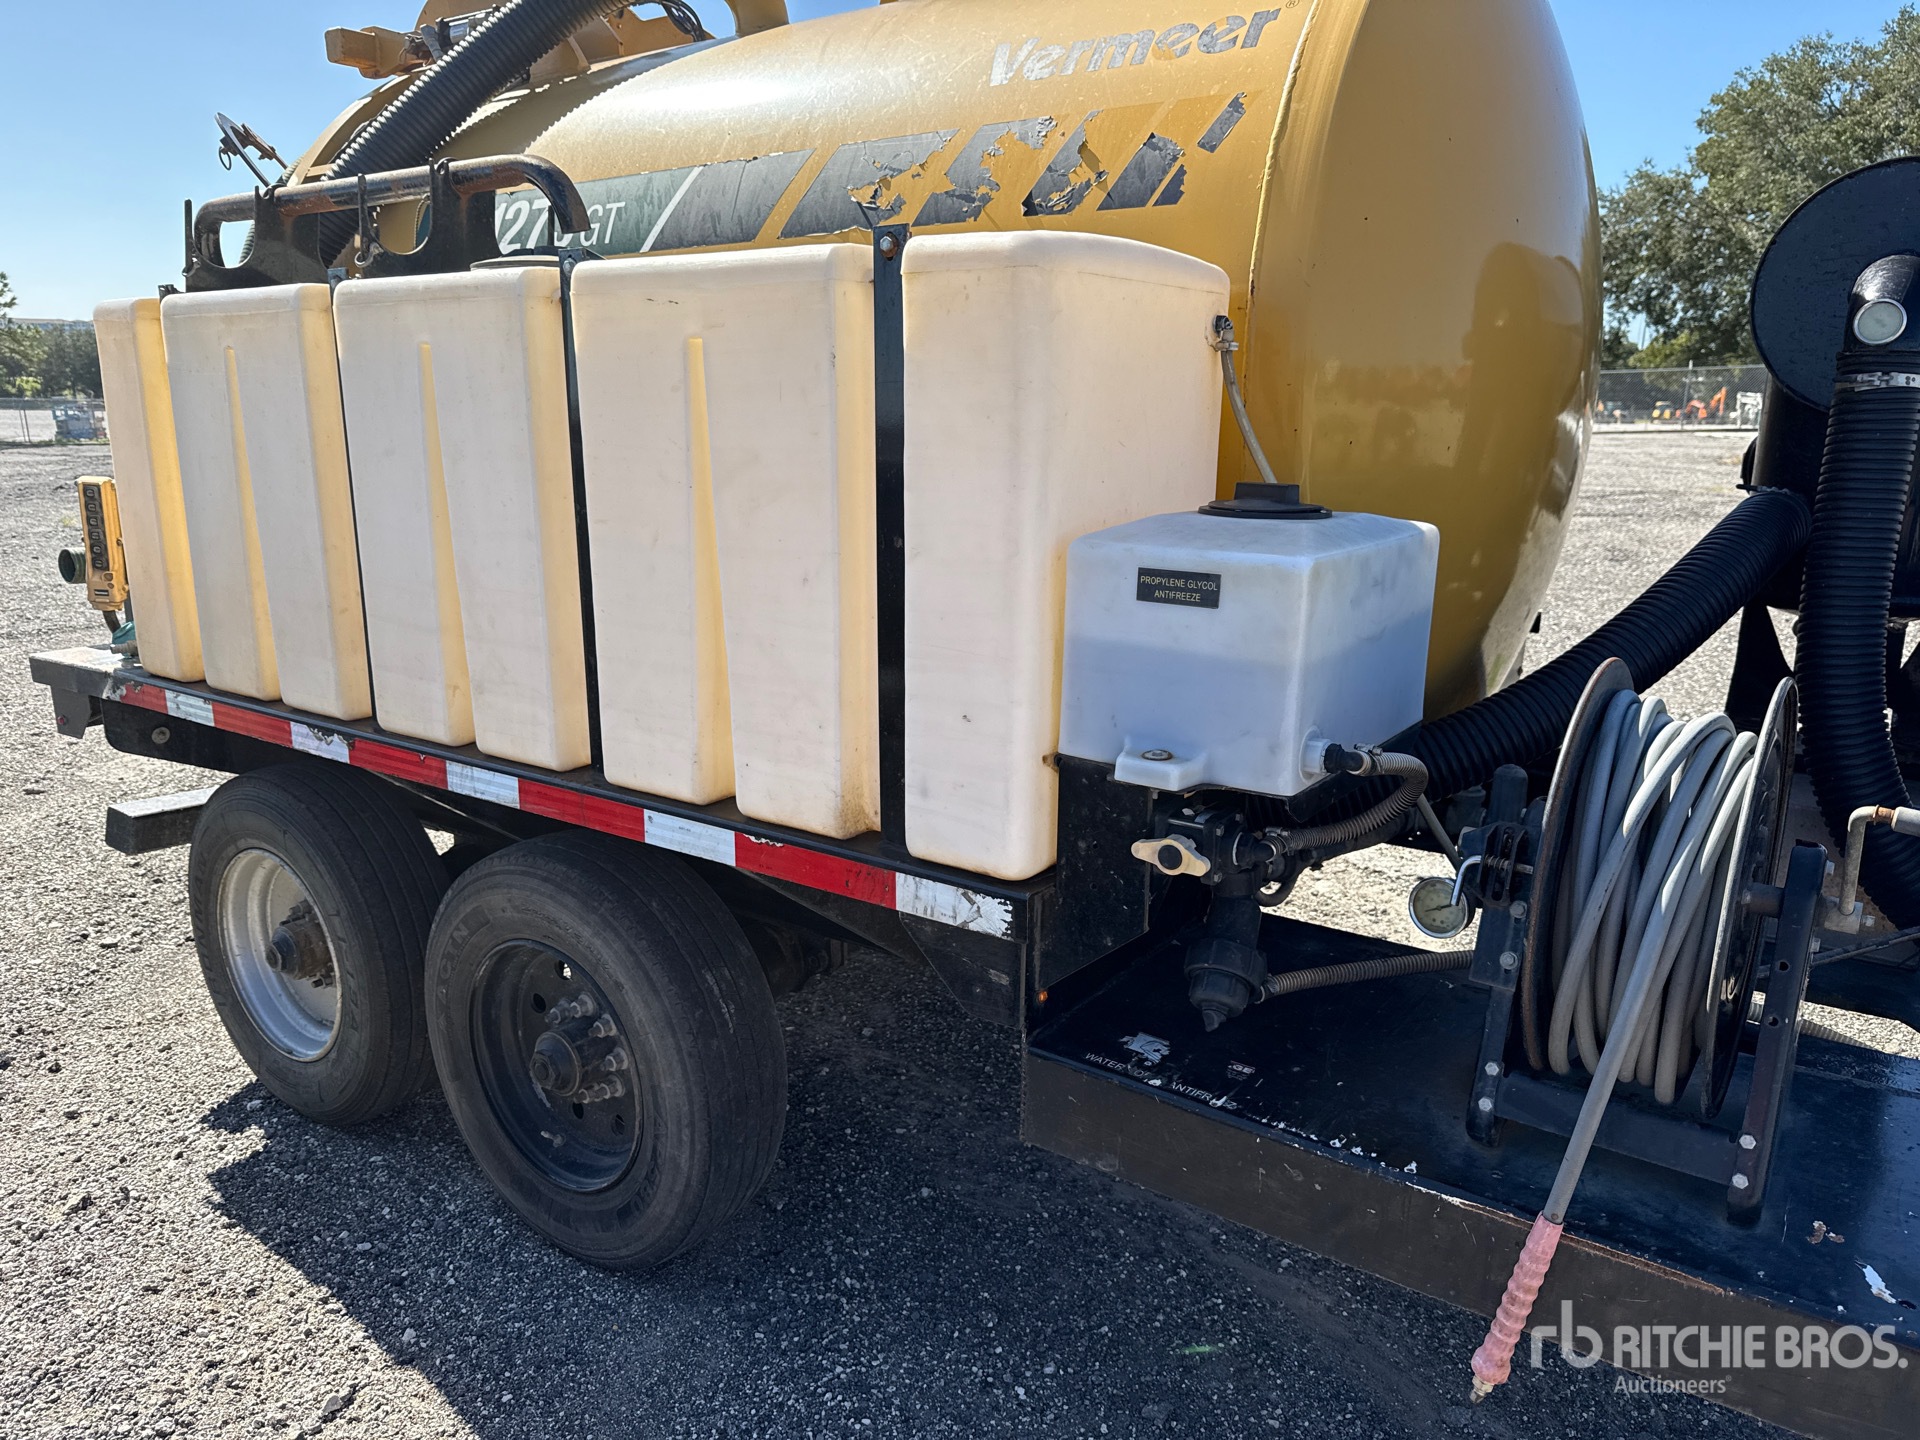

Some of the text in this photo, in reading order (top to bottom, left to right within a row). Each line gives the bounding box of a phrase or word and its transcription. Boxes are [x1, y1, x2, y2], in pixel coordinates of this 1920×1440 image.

[1140, 575, 1218, 591] PROPYLENE GLYCOL
[1154, 589, 1201, 602] ANTIFREEZE
[1085, 1052, 1126, 1073] WATER
[1169, 1081, 1238, 1110] ANTIFR
